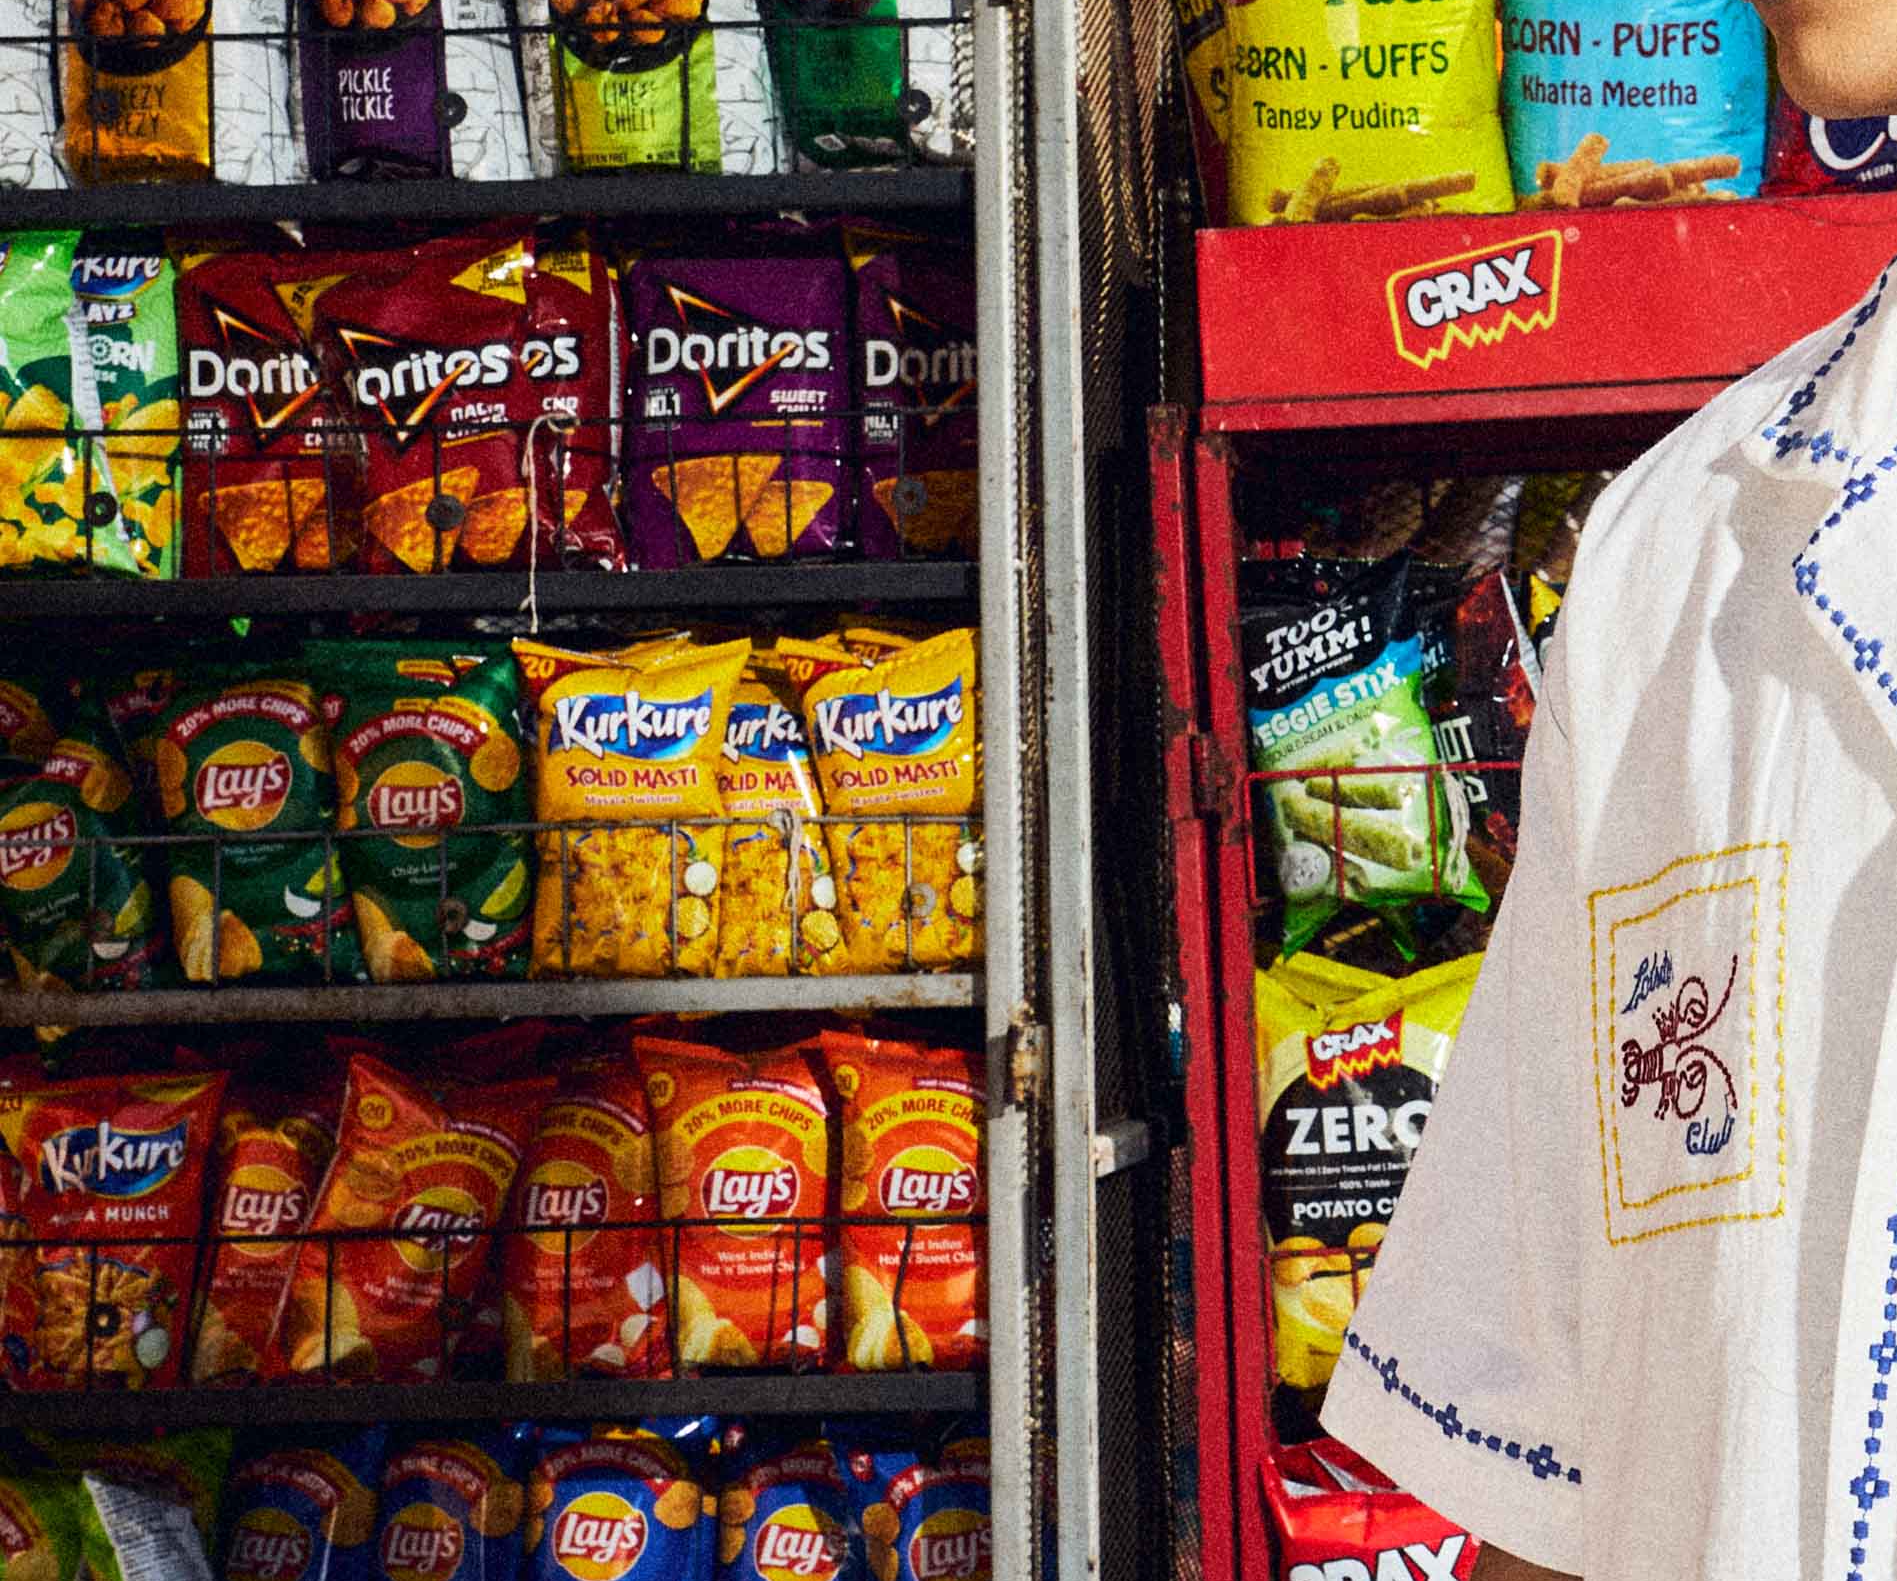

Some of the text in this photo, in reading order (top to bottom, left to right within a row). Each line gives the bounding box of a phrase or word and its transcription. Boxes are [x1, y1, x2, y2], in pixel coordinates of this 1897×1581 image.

[1506, 18, 1722, 58] CORN PUFFS
[1340, 40, 1450, 80] PUFFS
[338, 67, 393, 94] PICKLE
[1522, 75, 1698, 108] Khatta Meetha
[341, 93, 396, 121] TICKLE
[1252, 100, 1421, 131] Tangy Pudina
[1859, 164, 1895, 183] With
[1406, 247, 1545, 328] CRAX
[648, 326, 831, 375] Doritos
[769, 389, 828, 404] SWEET
[1265, 606, 1338, 656] TOO
[1250, 615, 1373, 692] YUMM!
[1333, 661, 1400, 710] STIX
[212, 696, 258, 716] MORE
[260, 697, 307, 725] CHIPS
[426, 714, 476, 746] CHIPS
[553, 689, 711, 760] Kurkure
[814, 687, 963, 760] Kurkure
[202, 760, 284, 810] Lay's
[564, 764, 698, 790] SOLID MASTI
[830, 759, 960, 790] SOLID MASTI
[378, 782, 457, 829] Lay's
[1311, 1020, 1395, 1062] CRAX
[717, 1099, 764, 1117] MORE
[768, 1102, 815, 1133] CHIPS
[900, 1098, 946, 1115] MORE
[221, 1184, 303, 1235] Lay's
[708, 1169, 794, 1219] Lay's
[886, 1166, 972, 1218] Lay's
[1292, 1199, 1374, 1220] POTATO
[104, 1205, 169, 1222] MUNCH
[701, 1264, 722, 1276] Hot
[387, 1523, 459, 1572] Lay's
[558, 1510, 640, 1564] Lay's
